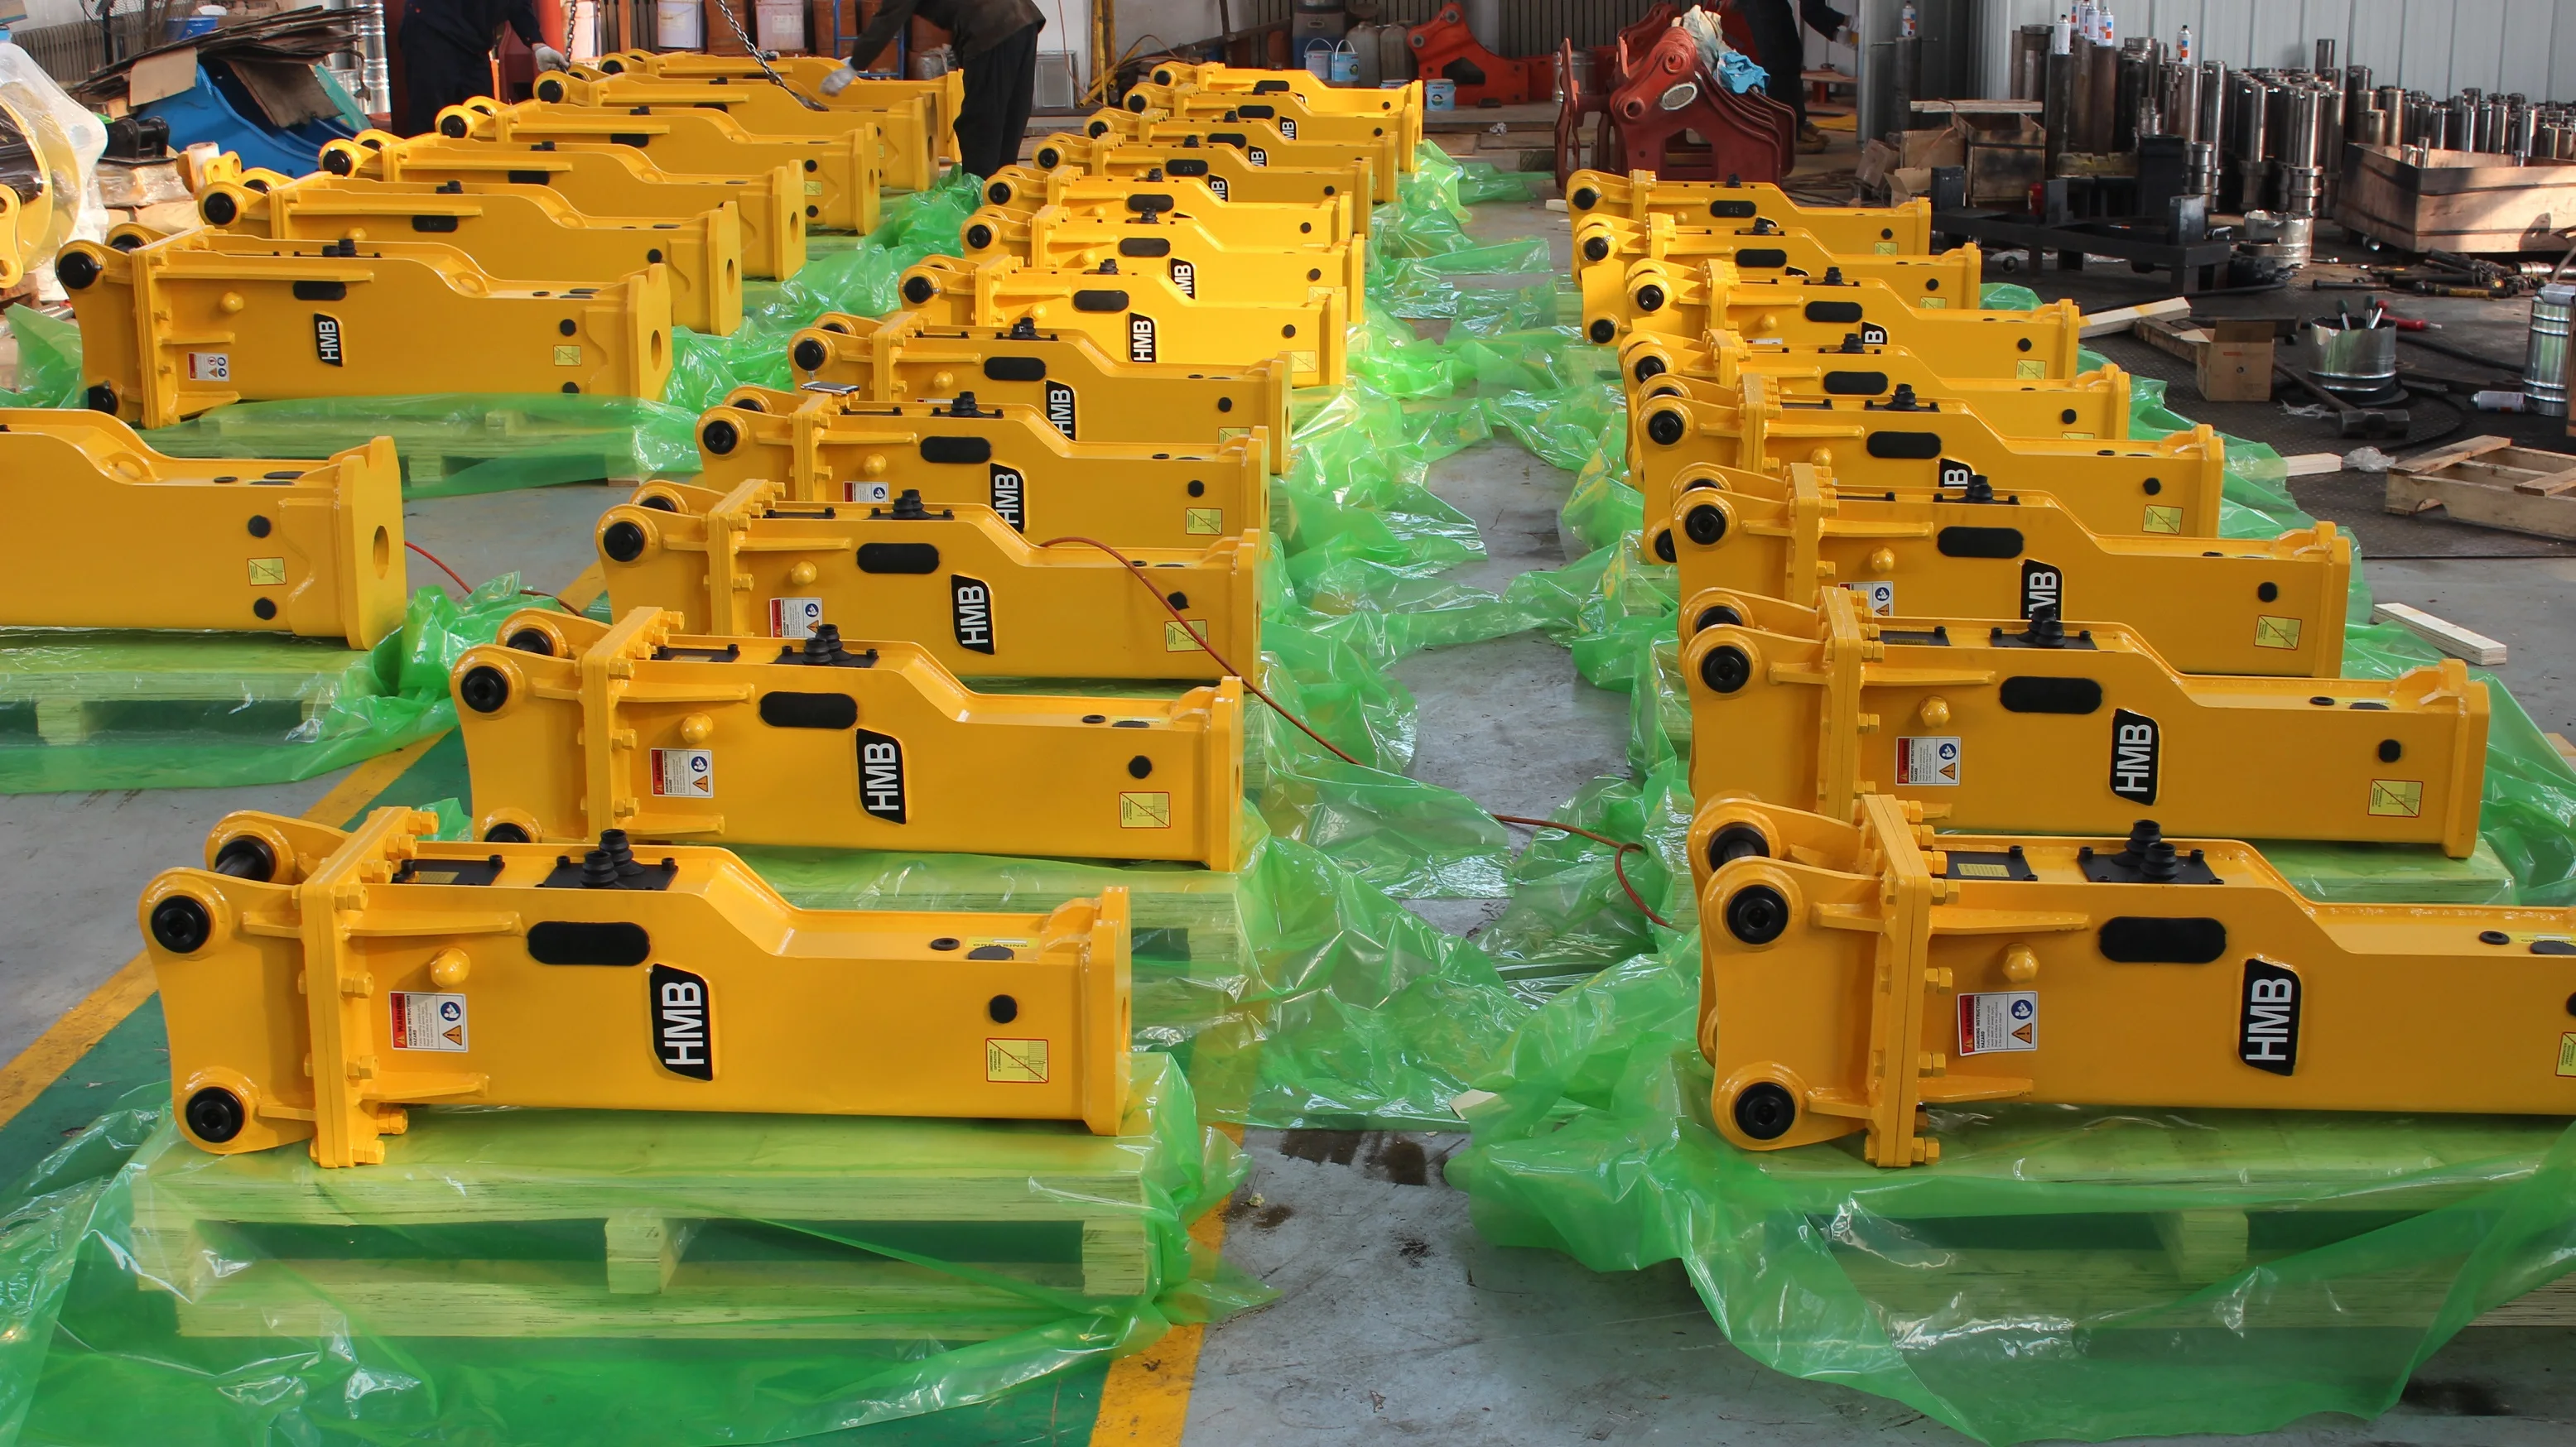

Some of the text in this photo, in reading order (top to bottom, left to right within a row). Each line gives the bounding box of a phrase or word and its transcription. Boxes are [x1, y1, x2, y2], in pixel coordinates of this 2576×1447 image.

[1282, 122, 1294, 140] MB
[1251, 151, 1264, 166] MB
[318, 321, 339, 359] HMB
[1133, 320, 1153, 361] HMB
[1050, 390, 1072, 434] HMB
[994, 474, 1019, 524] HMB
[957, 585, 989, 644] HMB
[2028, 572, 2057, 618] MB
[864, 743, 899, 810] HMB
[2116, 724, 2152, 792] HMB
[662, 982, 705, 1065] HMB
[2246, 978, 2292, 1060] HMB
